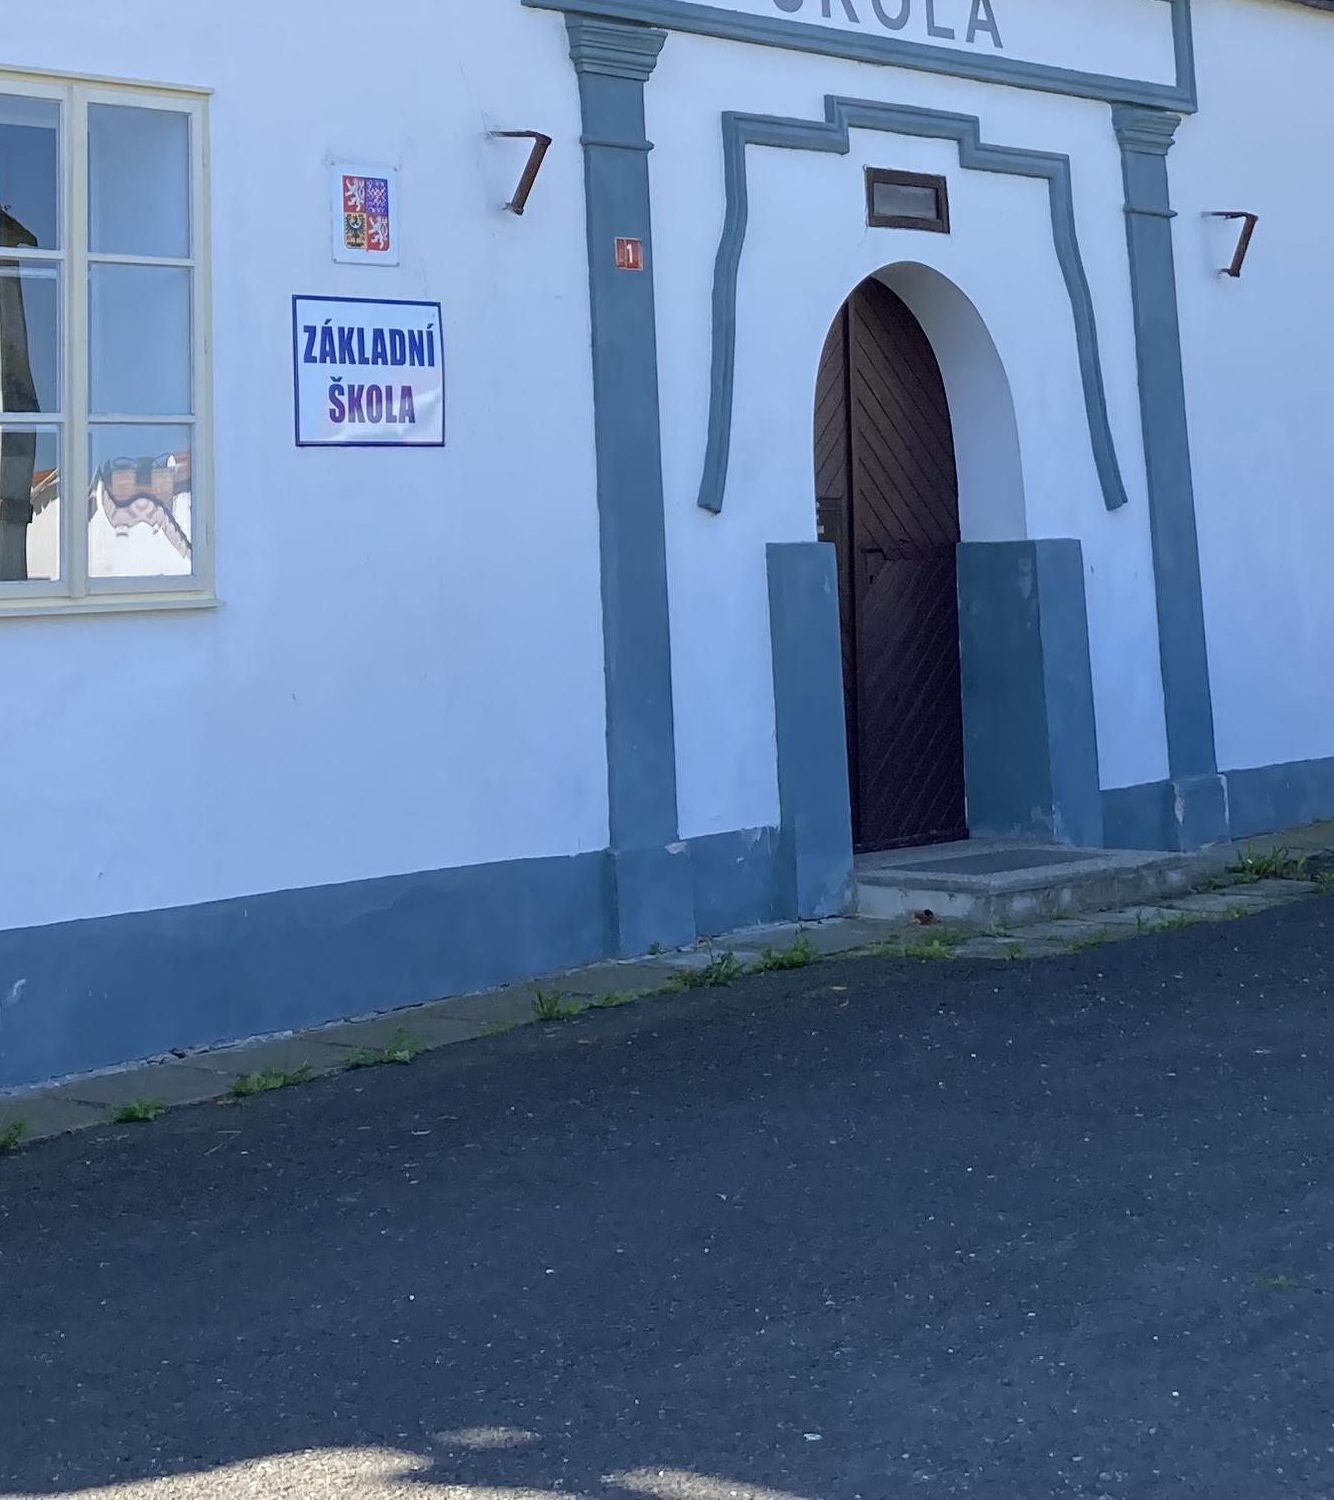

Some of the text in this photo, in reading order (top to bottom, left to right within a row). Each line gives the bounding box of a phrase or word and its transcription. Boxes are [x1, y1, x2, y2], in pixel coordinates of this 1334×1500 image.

[626, 243, 633, 264] 1
[303, 318, 435, 367] ZÁKLADNÍ
[328, 375, 416, 424] ŠKOLA
